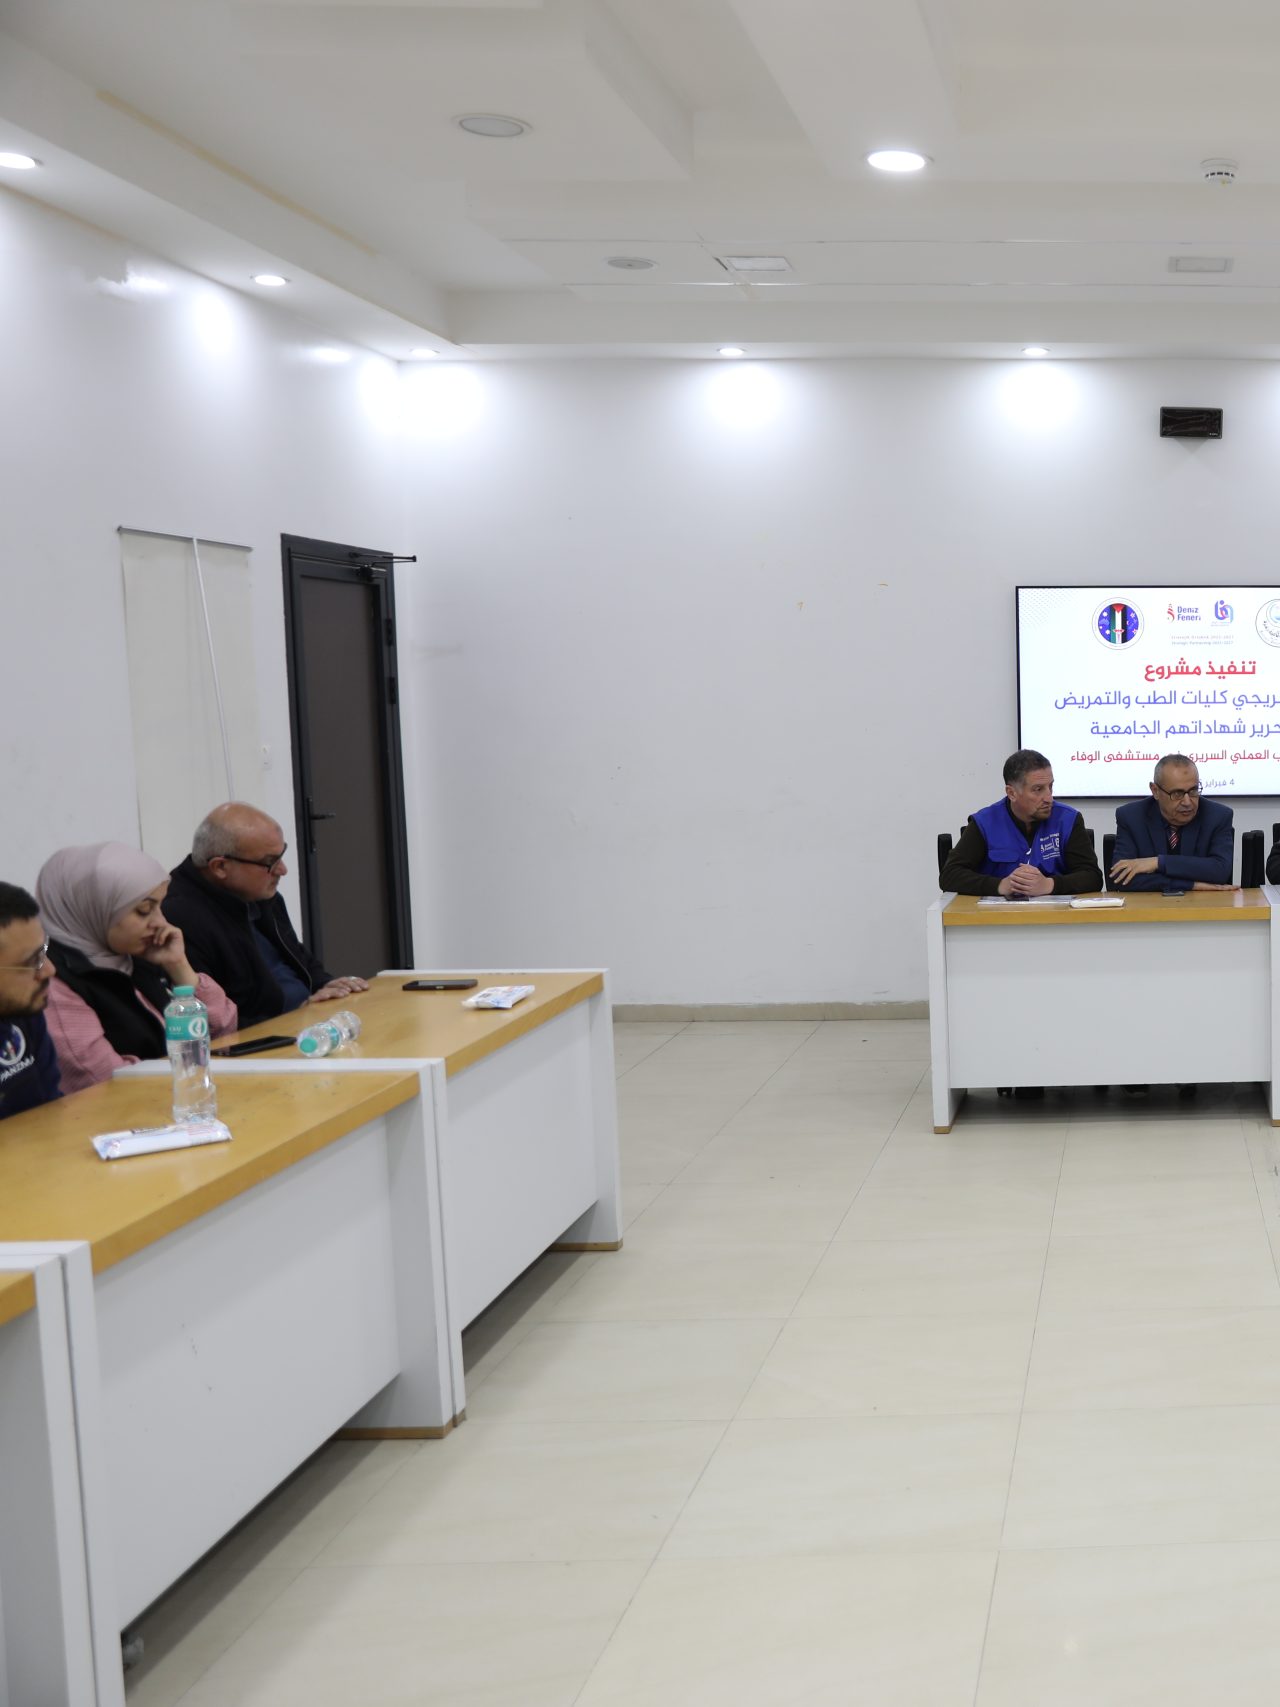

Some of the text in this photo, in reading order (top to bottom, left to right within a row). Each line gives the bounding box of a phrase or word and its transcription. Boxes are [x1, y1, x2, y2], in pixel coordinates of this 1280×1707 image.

[1177, 605, 1199, 614] Deniz
[1144, 657, 1257, 682] تنفيذ مشروع
[1054, 690, 1131, 710] والتمريض
[1135, 690, 1177, 709] الطب
[1181, 689, 1228, 708] كليات
[1090, 719, 1160, 739] الجامعية
[1165, 717, 1246, 739] شهاداتهم
[1070, 750, 1100, 764] الوفاء
[1103, 748, 1160, 763] مستشفى
[1230, 749, 1270, 764] العملي
[1229, 778, 1235, 786] 4
